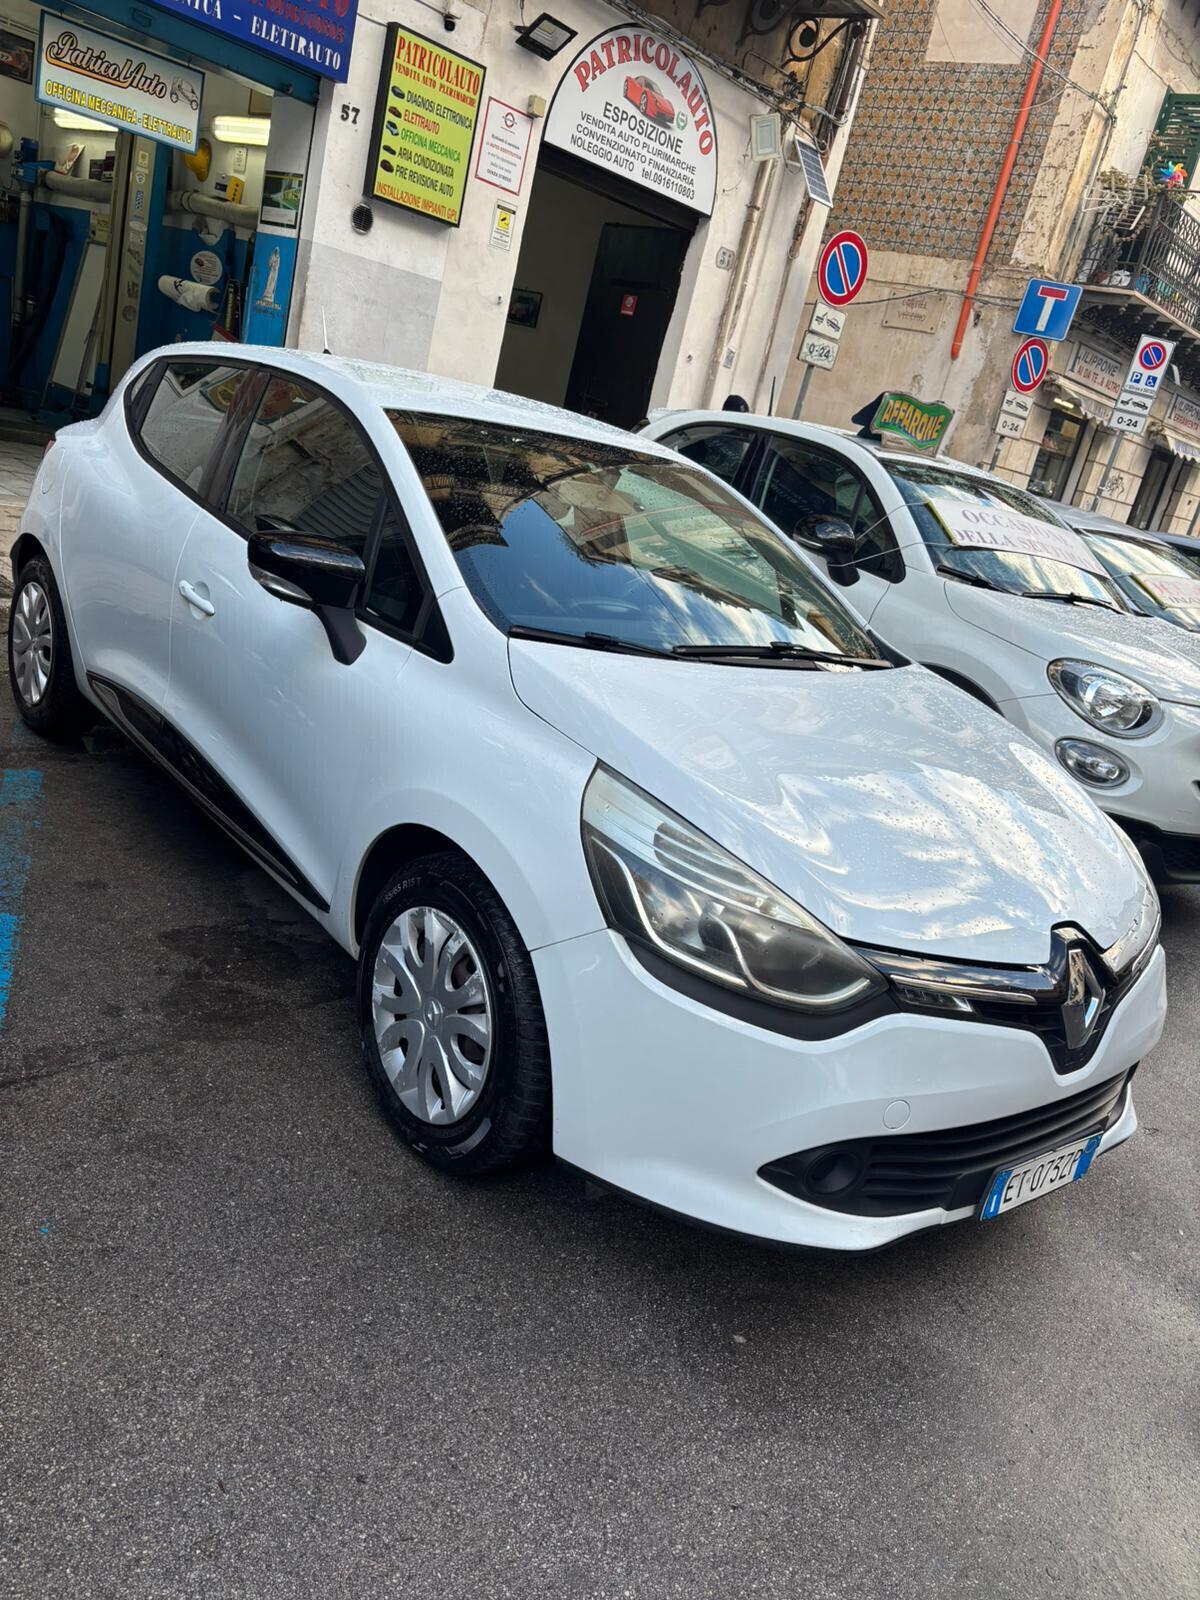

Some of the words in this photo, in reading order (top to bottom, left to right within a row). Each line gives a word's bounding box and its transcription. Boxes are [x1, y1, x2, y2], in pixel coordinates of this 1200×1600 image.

[251, 15, 341, 71] ELETTRAUTO
[396, 35, 480, 97] PATRICOLAUTO
[45, 80, 86, 107] OFFICINA
[87, 92, 137, 125] MECCANICA
[141, 113, 193, 144] ELETTRAUTO
[340, 103, 361, 125] 57
[406, 89, 436, 114] DIAGNOSI
[435, 103, 473, 131] ELETTRONICA
[573, 33, 714, 156] PATRICOLAUTO
[403, 109, 440, 135] ELETTRAUTO
[603, 101, 684, 155] ESPOSIZIONE
[397, 146, 412, 162] ARIA
[413, 152, 454, 179] CONDIZIONATA
[400, 127, 427, 150] OFFICINA
[427, 140, 461, 163] MECCANICA
[570, 133, 613, 162] NOLEGGIO
[613, 154, 635, 173] AUTO
[576, 123, 647, 164] CONVENZIONATO
[648, 157, 695, 188] FINANZIARIA
[580, 110, 616, 137] VENDITA
[617, 129, 641, 148] AUTO
[642, 142, 697, 176] PLURIMARCHE
[376, 182, 421, 208] INSTALLAZIONE
[421, 198, 447, 218] IMPIANTI
[395, 164, 408, 180] PRE
[408, 169, 440, 192] REVISIONE
[439, 181, 454, 197] AUTO
[881, 399, 945, 440] AFFARONE
[1001, 420, 1020, 432] 0-24
[1117, 416, 1138, 428] 0-24
[1003, 1168, 1031, 1204] ET
[1030, 1148, 1084, 1192] 073ZP
